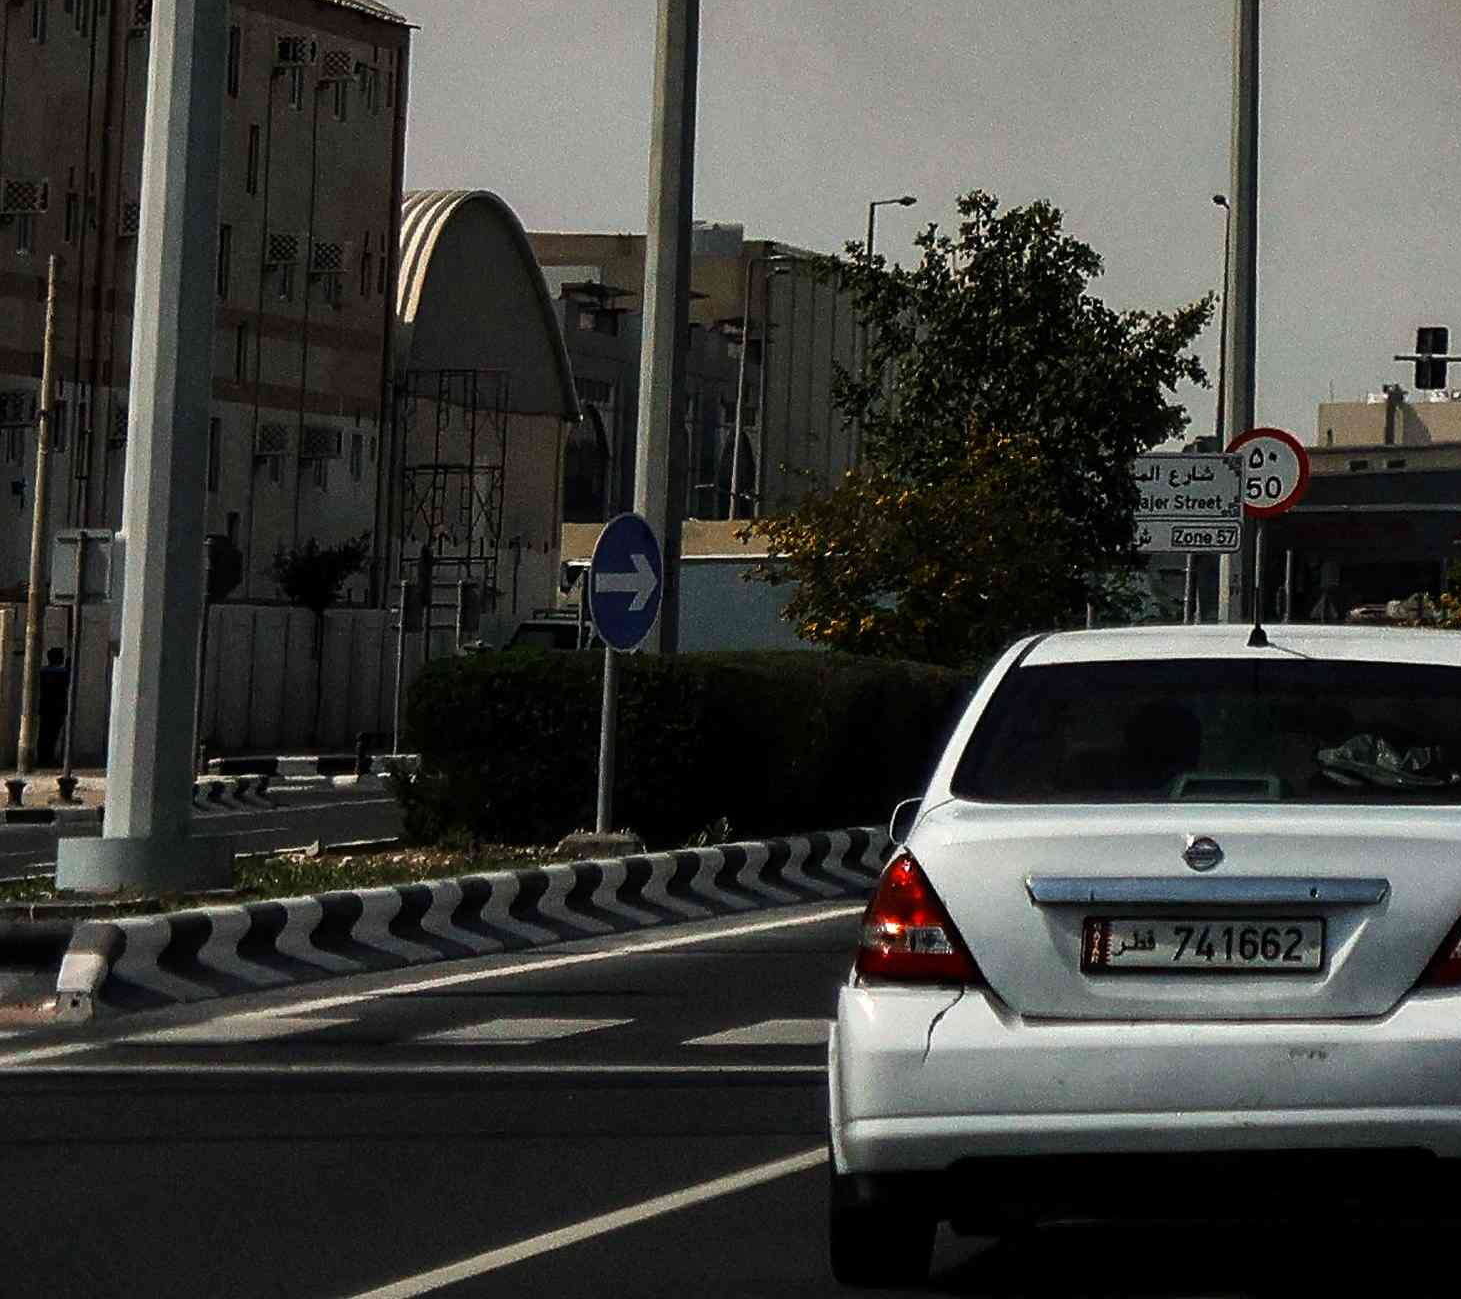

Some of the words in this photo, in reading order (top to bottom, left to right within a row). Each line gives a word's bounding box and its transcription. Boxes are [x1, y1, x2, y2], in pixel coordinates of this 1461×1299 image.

[1168, 465, 1214, 488] شارع
[1246, 475, 1282, 500] 50
[1174, 494, 1223, 510] Street
[1173, 529, 1213, 545] Zone
[1216, 529, 1236, 544] 57
[1172, 925, 1304, 963] 741662
